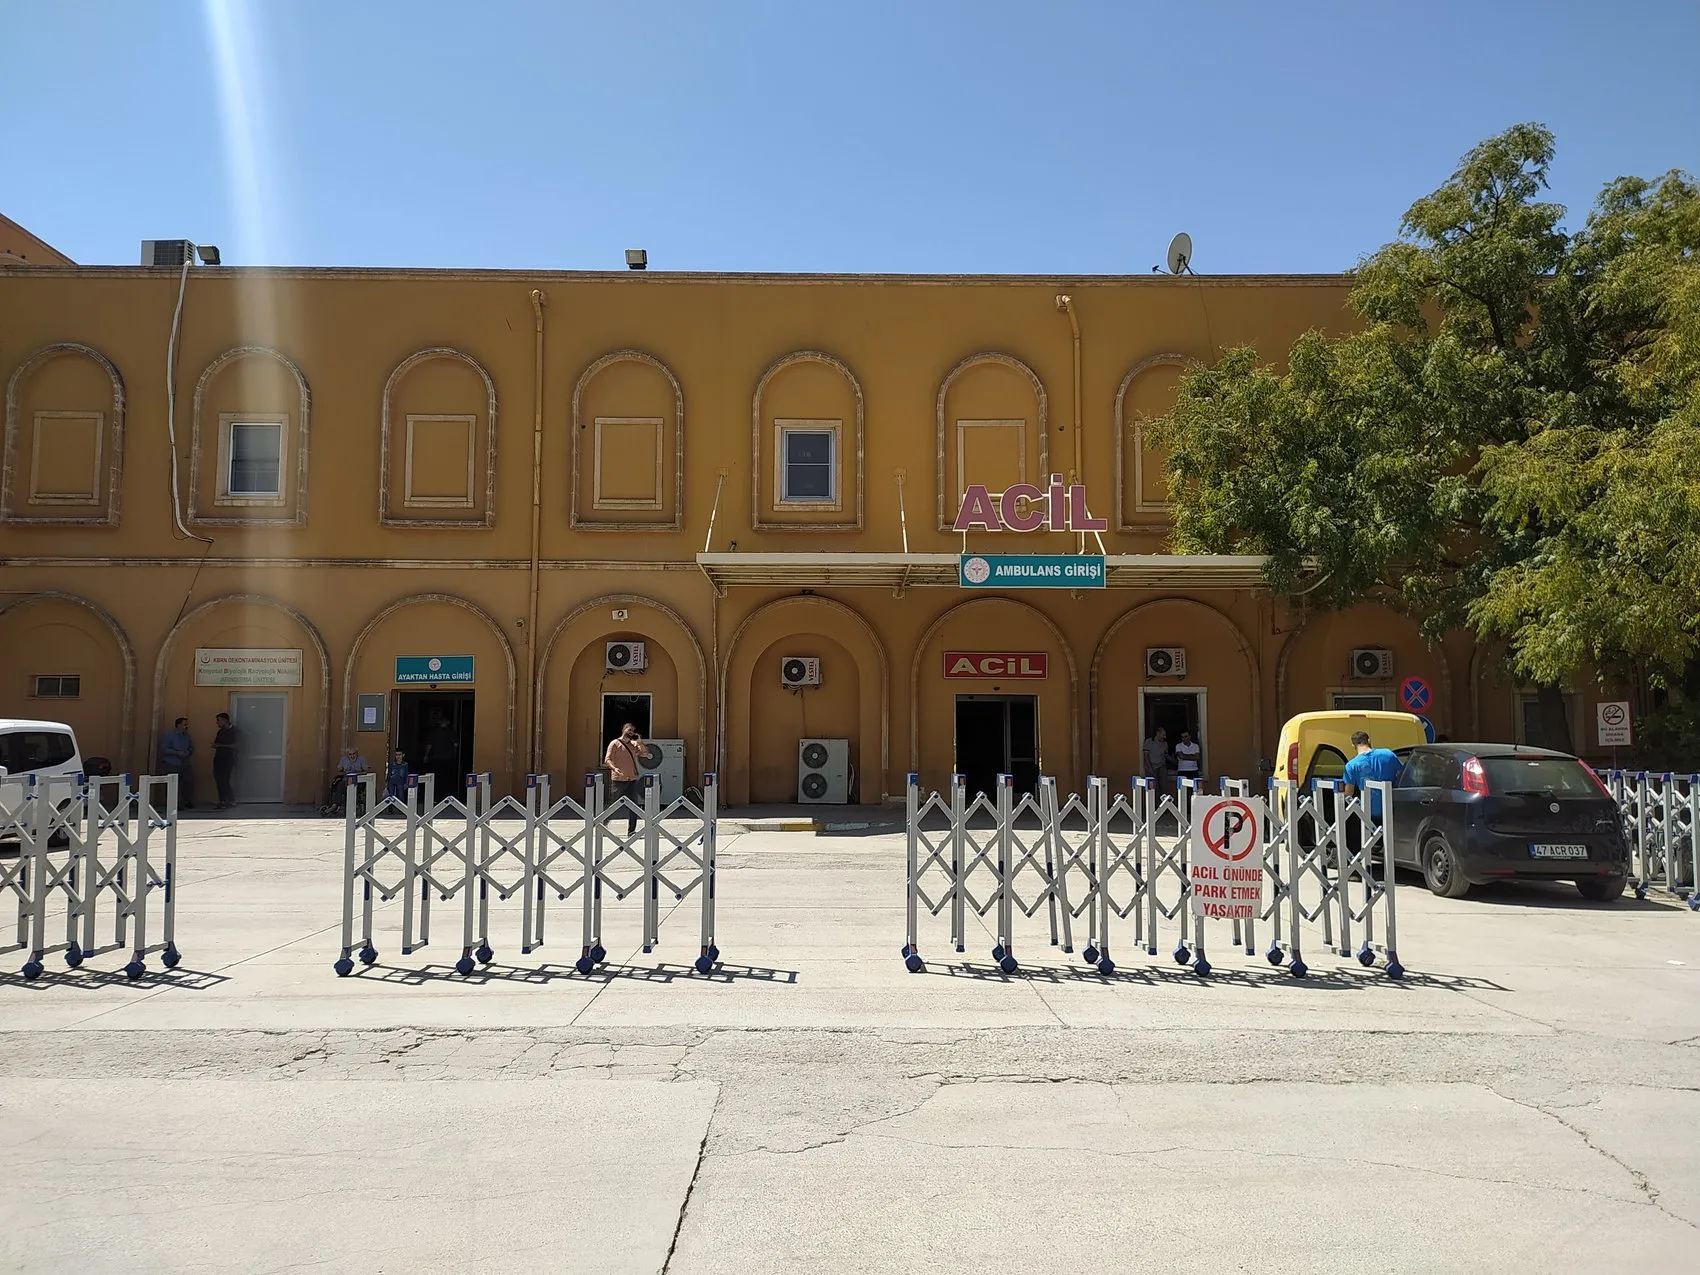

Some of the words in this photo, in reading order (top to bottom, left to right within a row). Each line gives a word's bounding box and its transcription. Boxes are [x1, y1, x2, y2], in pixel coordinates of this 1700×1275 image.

[952, 473, 1108, 532] ACİL
[995, 565, 1061, 577] AMBULANS
[1064, 563, 1101, 579] GİRİŞİ
[398, 673, 428, 681] AYAKTAN
[429, 672, 451, 680] HASTA
[451, 671, 472, 681] GİRİŞİ
[1536, 846, 1547, 855] 47
[1550, 846, 1568, 855] ACR
[1568, 846, 1585, 855] 037
[1223, 865, 1262, 882] ÖNÜNDE
[1194, 884, 1227, 899] PARK
[1231, 886, 1260, 900] ETMEK
[1203, 903, 1253, 918] YASAKTIR
